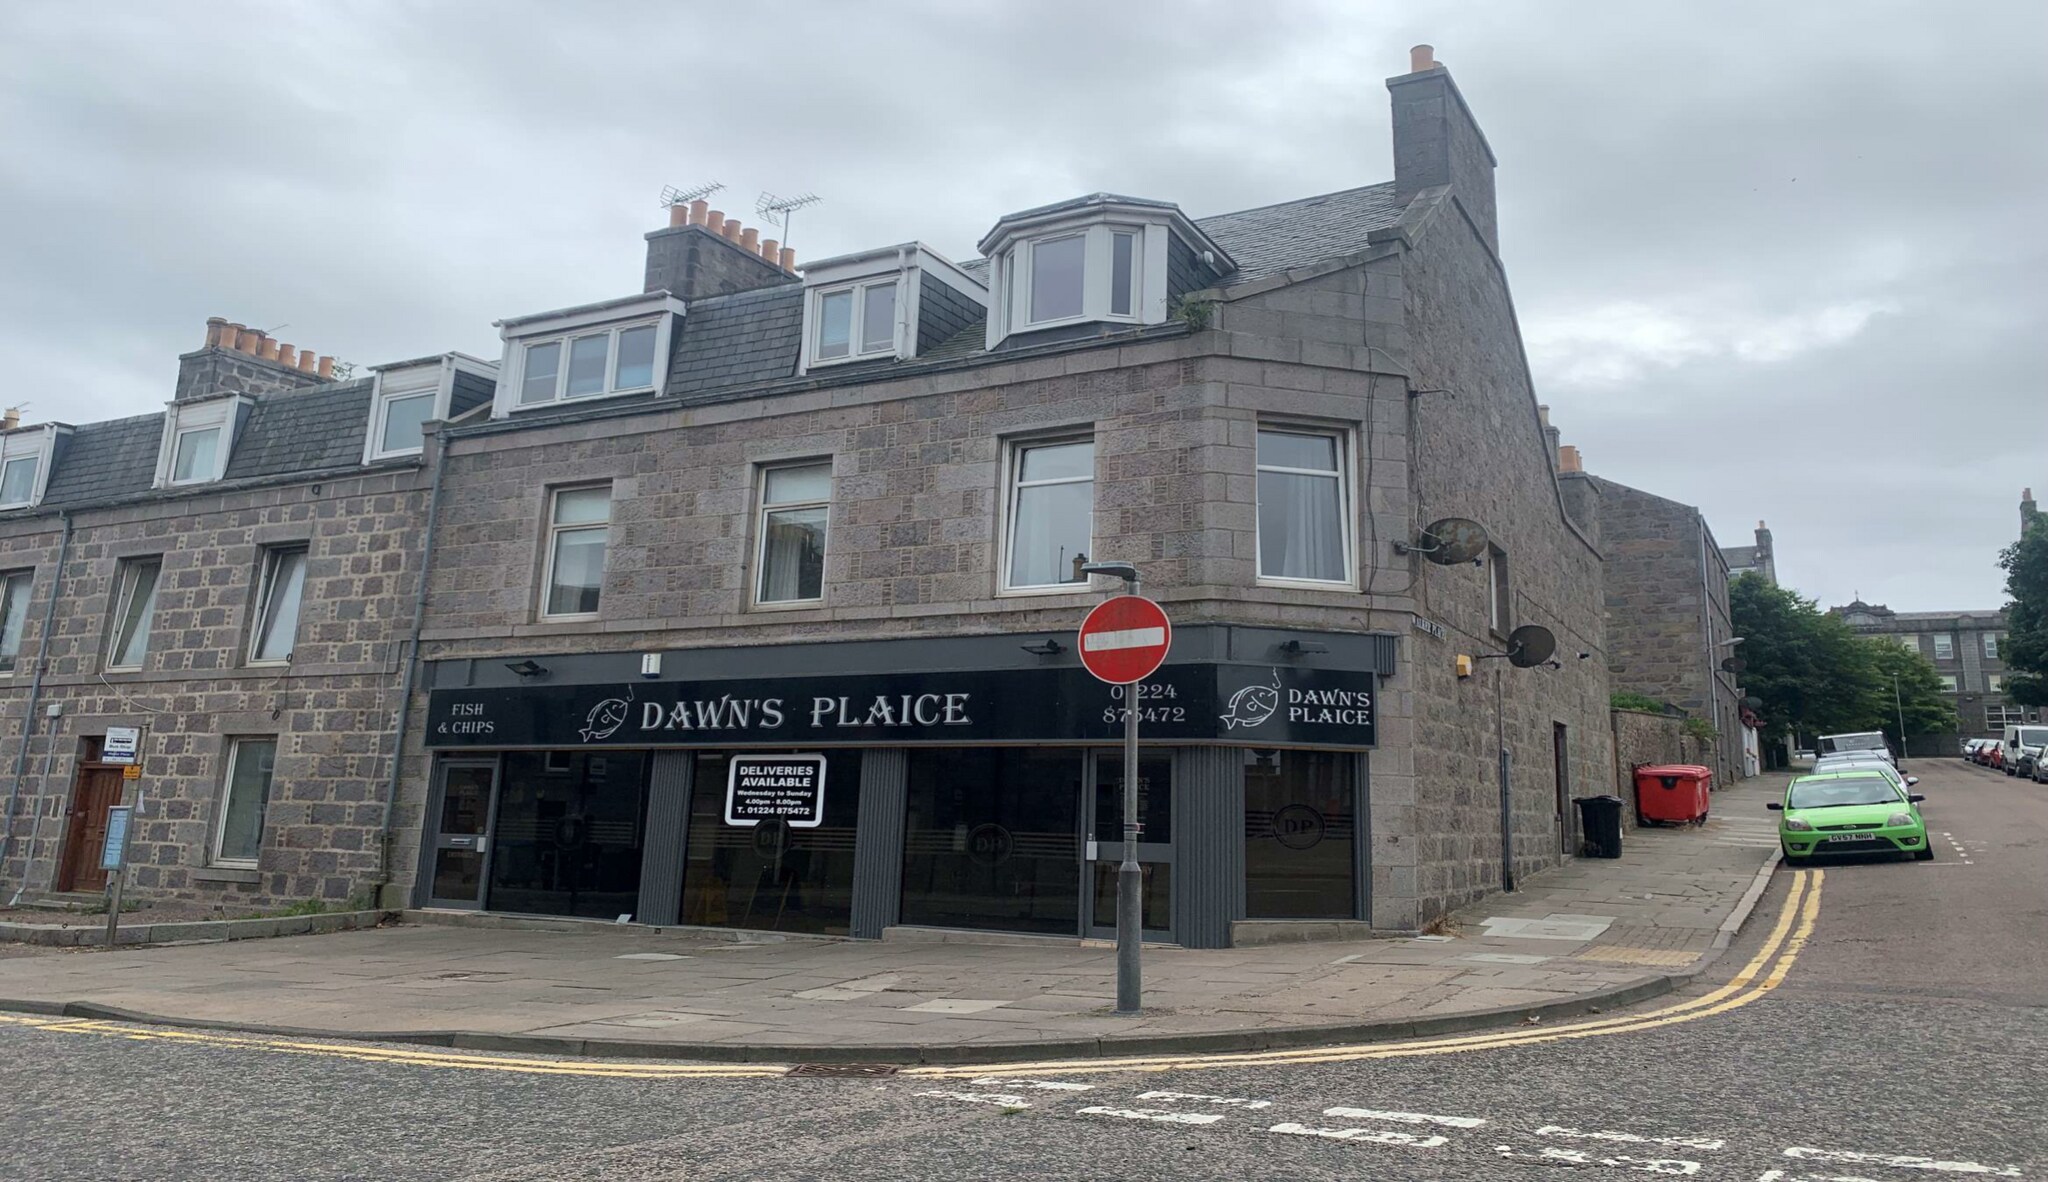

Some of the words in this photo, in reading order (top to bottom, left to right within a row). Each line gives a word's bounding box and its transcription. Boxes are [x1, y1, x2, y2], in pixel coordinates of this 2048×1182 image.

[1110, 684, 1177, 700] 0224
[1288, 688, 1371, 707] DAWN'S
[452, 703, 484, 716] FISH
[640, 693, 784, 730] DAWN'S
[810, 693, 972, 727] PLAICE
[1288, 706, 1371, 725] PLAICE
[437, 721, 448, 734] &
[452, 720, 495, 734] CHIPS
[740, 766, 813, 775] DELIVERIES
[741, 778, 811, 787] AVAILABLE
[776, 807, 810, 815] 875472
[1284, 818, 1314, 834] DP
